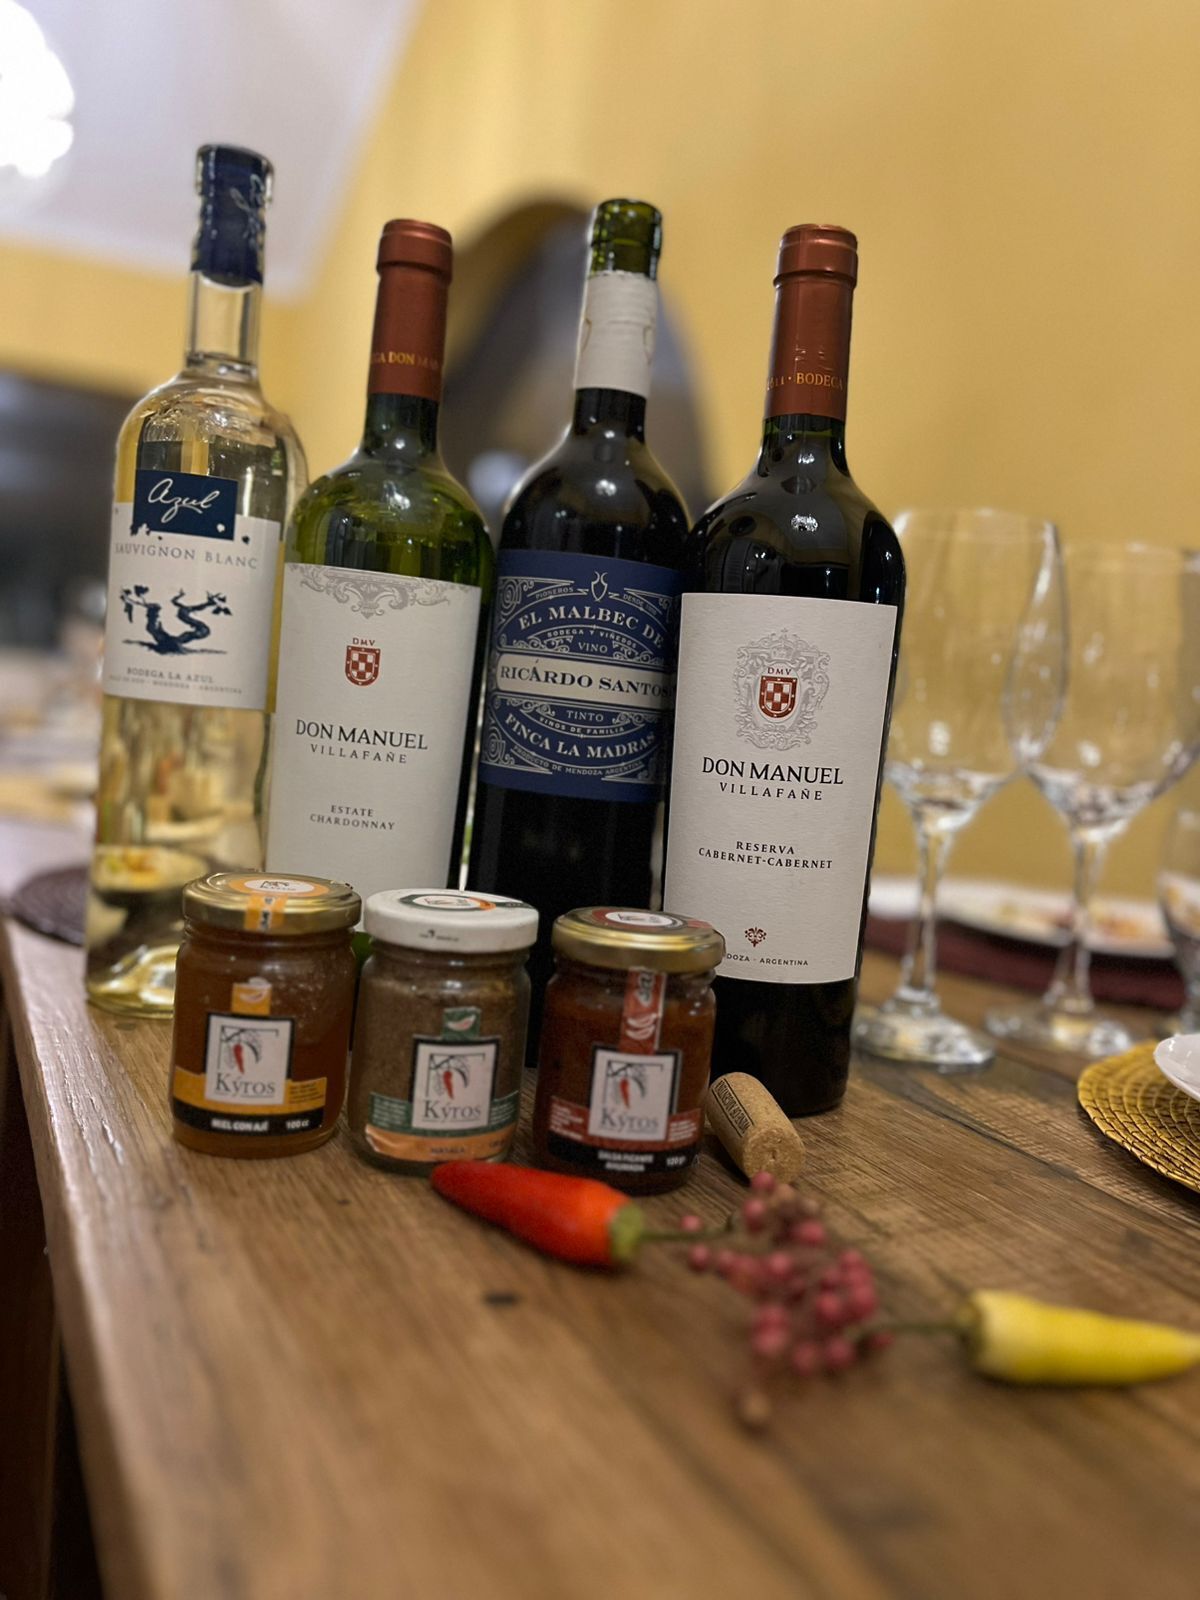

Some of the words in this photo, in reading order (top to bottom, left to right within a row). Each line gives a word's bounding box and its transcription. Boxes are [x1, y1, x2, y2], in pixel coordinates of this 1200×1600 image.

[388, 351, 415, 365] DON
[147, 477, 220, 524] Azul
[205, 552, 259, 570] BLANC
[518, 611, 542, 630] EL
[548, 605, 639, 630] MALBEC
[642, 622, 664, 648] DE
[547, 628, 584, 638] BODEGA
[352, 637, 376, 647] DMV
[577, 641, 608, 654] VINO
[126, 667, 165, 681] BODEGA
[168, 670, 182, 681] LA
[186, 673, 214, 685] AZUL
[767, 666, 792, 676] DMV
[566, 709, 605, 723] TINTO
[296, 719, 335, 740] DON
[338, 726, 428, 750] MANUEL
[505, 712, 552, 750] FINCA
[556, 741, 581, 757] LA
[310, 743, 407, 764] VILLAFAÑE
[551, 763, 562, 772] DE
[565, 765, 604, 776] MENDOZA
[702, 757, 745, 777] DON
[750, 763, 844, 785] MANUEL
[719, 781, 823, 801] VILLAFAÑE
[330, 804, 374, 818] ESTATE
[310, 814, 396, 831] CHARDONNAY
[736, 840, 795, 855] RESERVA
[698, 847, 832, 869] CABERNET-CABERNET
[726, 952, 750, 963] DOZA
[759, 957, 809, 966] ARGENTINA
